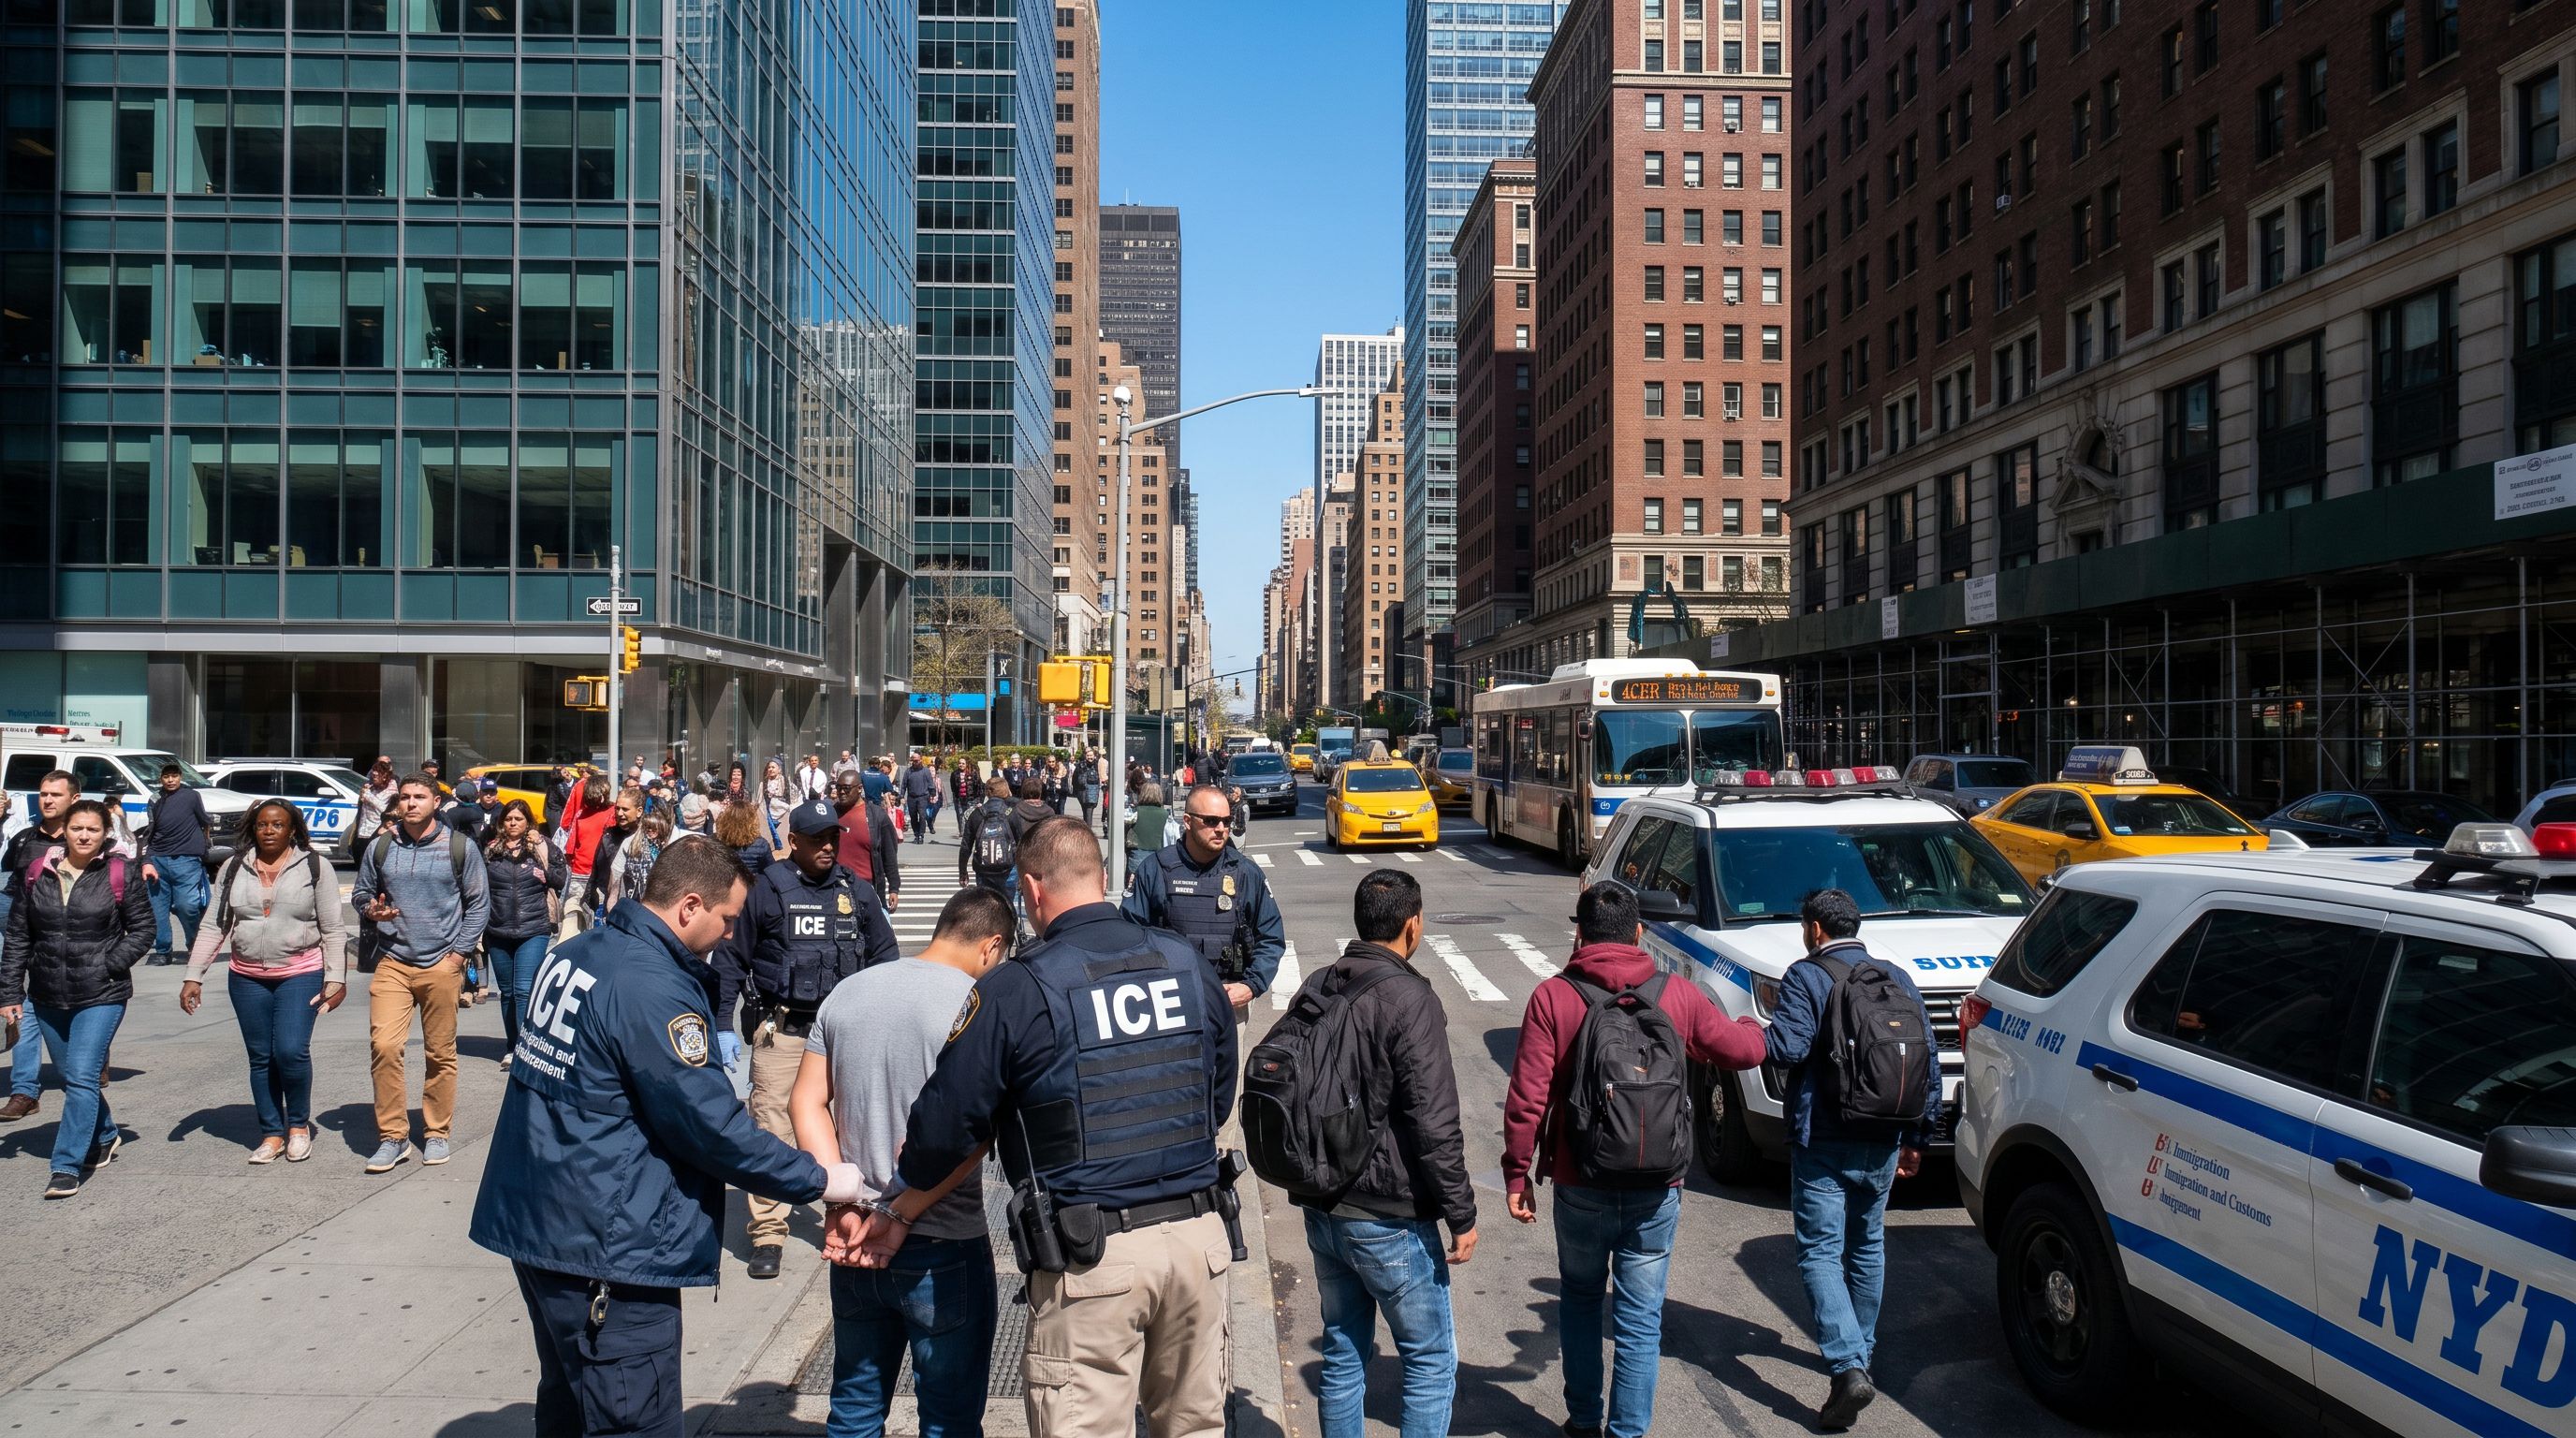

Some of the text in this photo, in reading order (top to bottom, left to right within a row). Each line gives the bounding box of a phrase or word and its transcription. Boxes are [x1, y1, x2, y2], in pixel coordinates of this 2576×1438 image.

[795, 916, 826, 934] ICE
[527, 953, 597, 1045] ICE
[1090, 978, 1186, 1040] ICE
[556, 1049, 576, 1066] and
[2209, 1190, 2227, 1206] and
[2229, 1194, 2271, 1226] Customs
[2358, 1224, 2576, 1408] NYD
